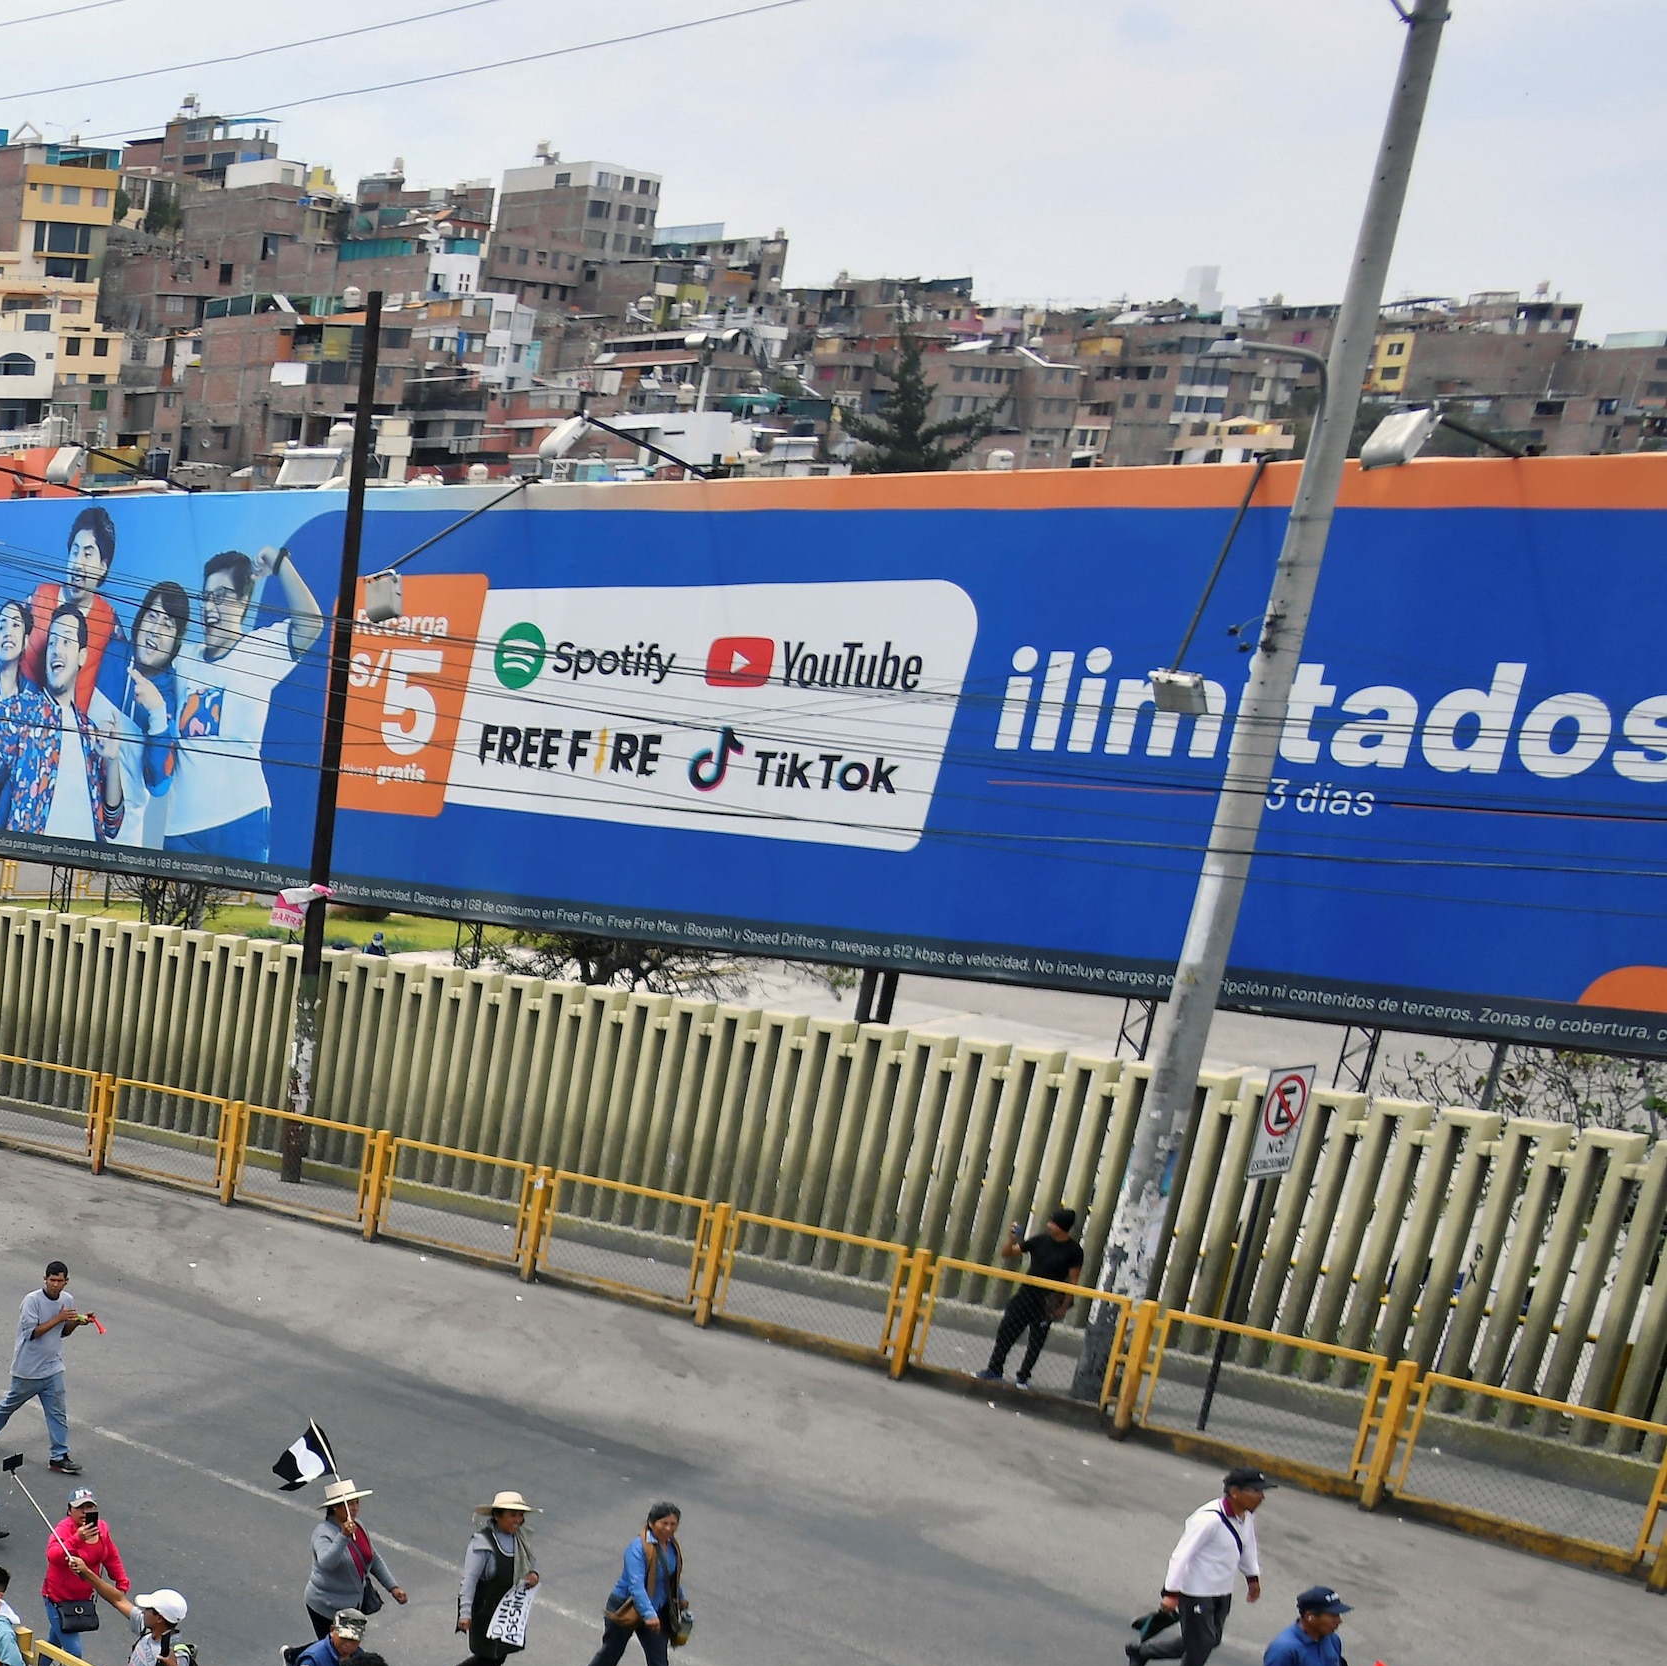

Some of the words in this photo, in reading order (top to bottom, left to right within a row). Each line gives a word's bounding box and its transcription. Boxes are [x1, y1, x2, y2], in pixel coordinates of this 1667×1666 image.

[552, 641, 676, 687] Spotify
[782, 641, 923, 691] YouTube
[479, 723, 563, 771] FREE
[375, 762, 426, 785] gratis
[754, 749, 900, 794] TikTok
[12, 837, 28, 851] para
[88, 848, 100, 859] las
[117, 851, 145, 867] Después
[145, 856, 156, 867] de
[171, 860, 181, 871] de
[181, 861, 213, 875] consumo
[213, 866, 224, 875] en
[224, 867, 253, 881] Youtube
[358, 884, 370, 896] de
[413, 891, 450, 908] Después
[450, 896, 463, 909] de
[482, 901, 495, 913] de
[495, 904, 540, 919] consumo
[542, 909, 556, 920] en
[557, 908, 580, 923] Free
[607, 914, 632, 930] Free
[633, 916, 656, 932] Fire
[742, 928, 779, 947] Speed
[830, 939, 881, 957] navegas
[882, 945, 892, 957] a
[892, 944, 913, 960] 512
[914, 946, 946, 965] kbps
[946, 950, 965, 966] de
[966, 953, 1032, 972] velocidad.
[1034, 958, 1055, 974] No
[1055, 960, 1105, 981] incluye
[1106, 967, 1155, 987] cargos
[1271, 981, 1287, 998] ni
[1289, 987, 1376, 1012] contenidos
[1377, 995, 1398, 1013] de
[1400, 998, 1474, 1022] terceros.
[1477, 1006, 1531, 1029] Zonas
[1534, 1014, 1557, 1031] de
[1558, 1016, 1653, 1041] cobertura,
[1267, 1140, 1284, 1154] NO
[491, 1594, 511, 1638] DINA
